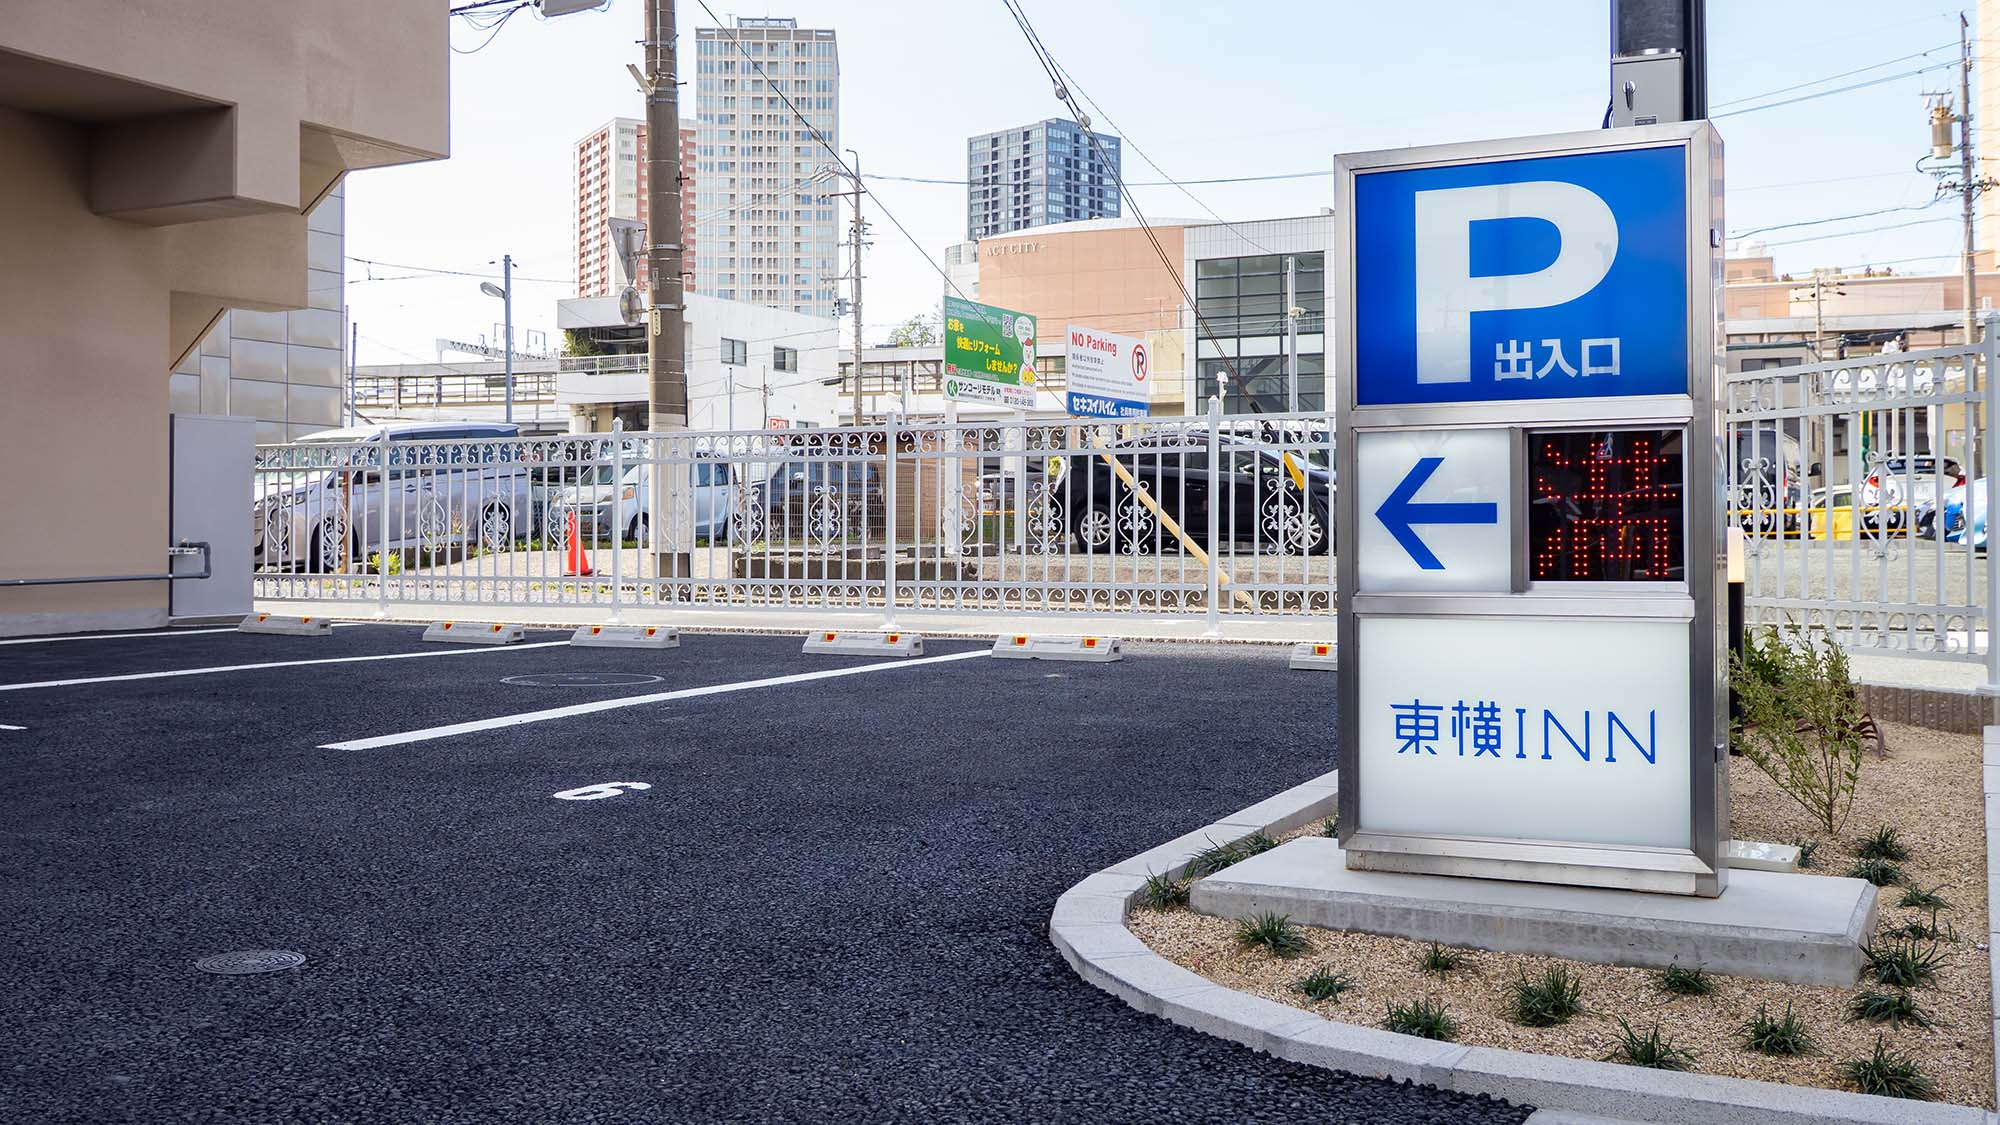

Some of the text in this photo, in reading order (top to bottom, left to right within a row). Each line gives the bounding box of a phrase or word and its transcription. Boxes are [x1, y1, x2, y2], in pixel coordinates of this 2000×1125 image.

[985, 241, 1039, 257] ACT CITY
[1415, 181, 1618, 384] P
[1071, 331, 1117, 357] NO Parking
[1494, 337, 1620, 381] 出入口
[1072, 395, 1117, 416] セキスイハイム
[1539, 441, 1676, 576] 満
[1389, 699, 1656, 765] 東横INN
